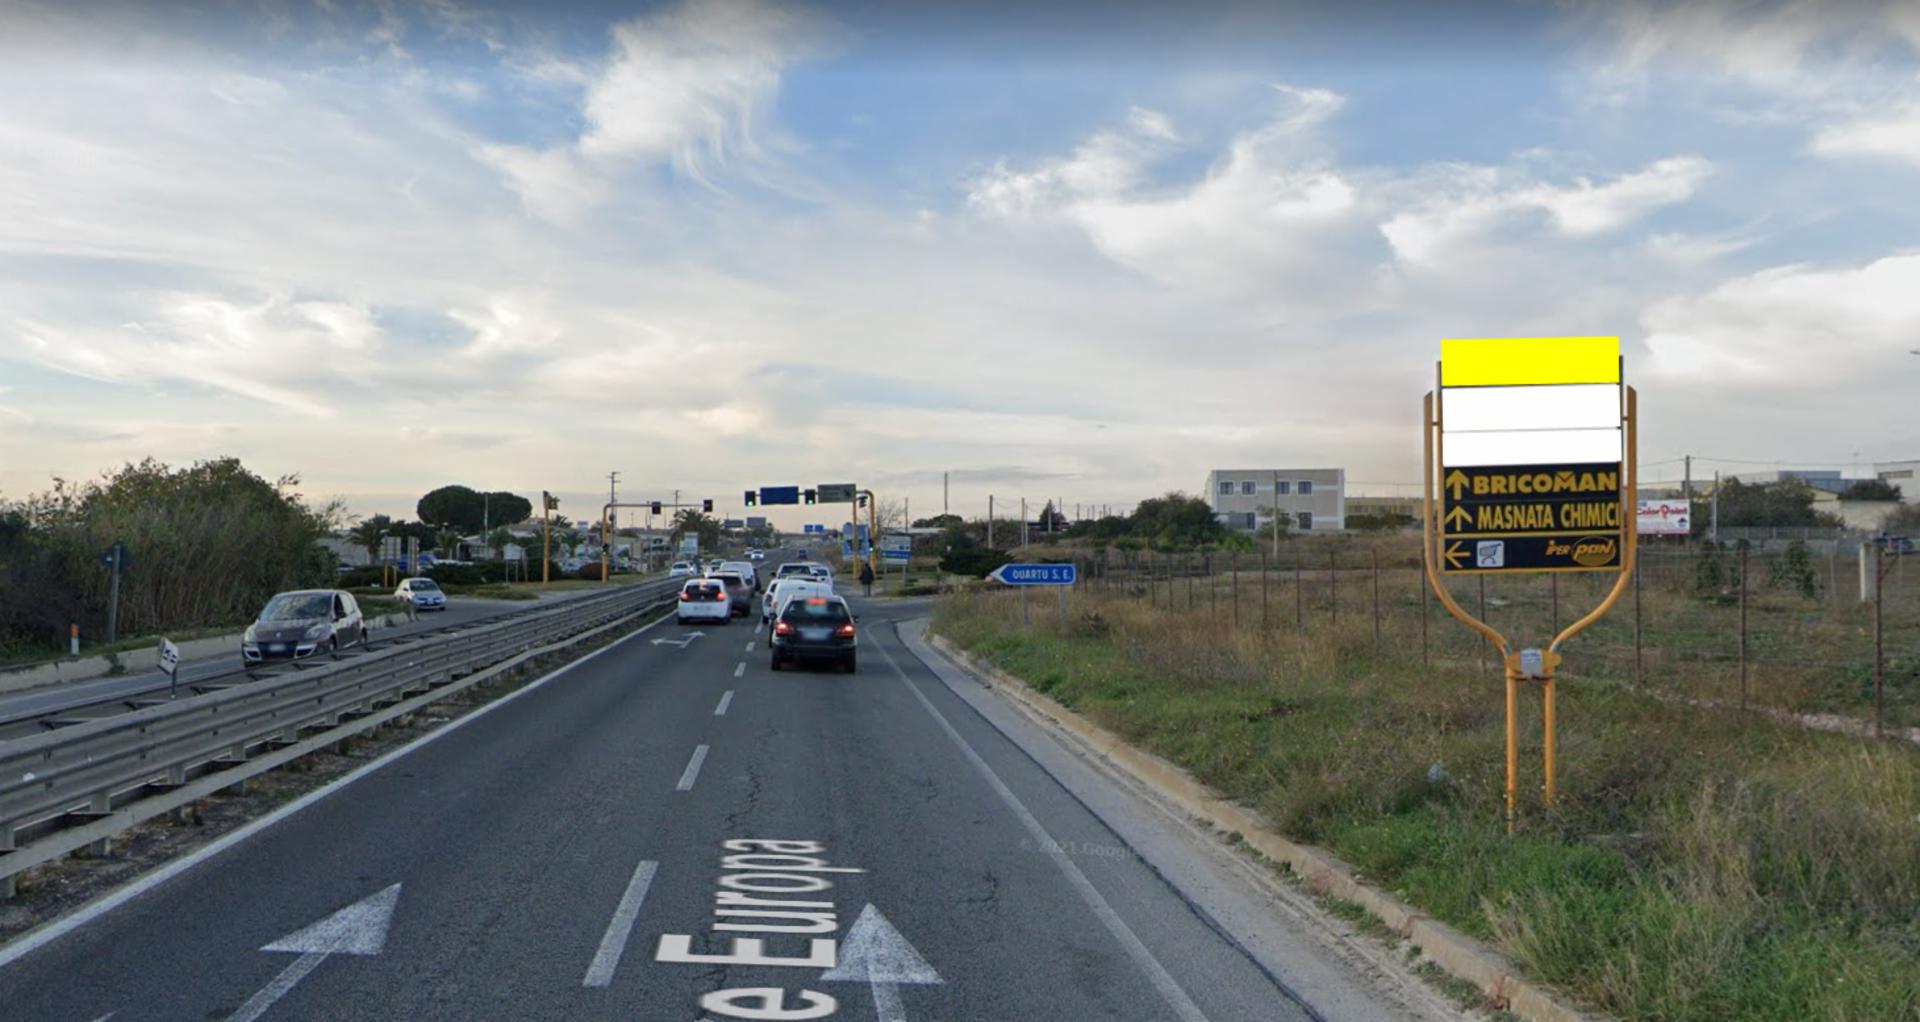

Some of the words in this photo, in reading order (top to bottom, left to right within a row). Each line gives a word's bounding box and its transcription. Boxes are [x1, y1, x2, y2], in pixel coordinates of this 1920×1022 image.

[1473, 471, 1617, 495] BRICOMAN
[1477, 504, 1554, 530] MASNATA
[1560, 502, 1620, 528] CHIMICI
